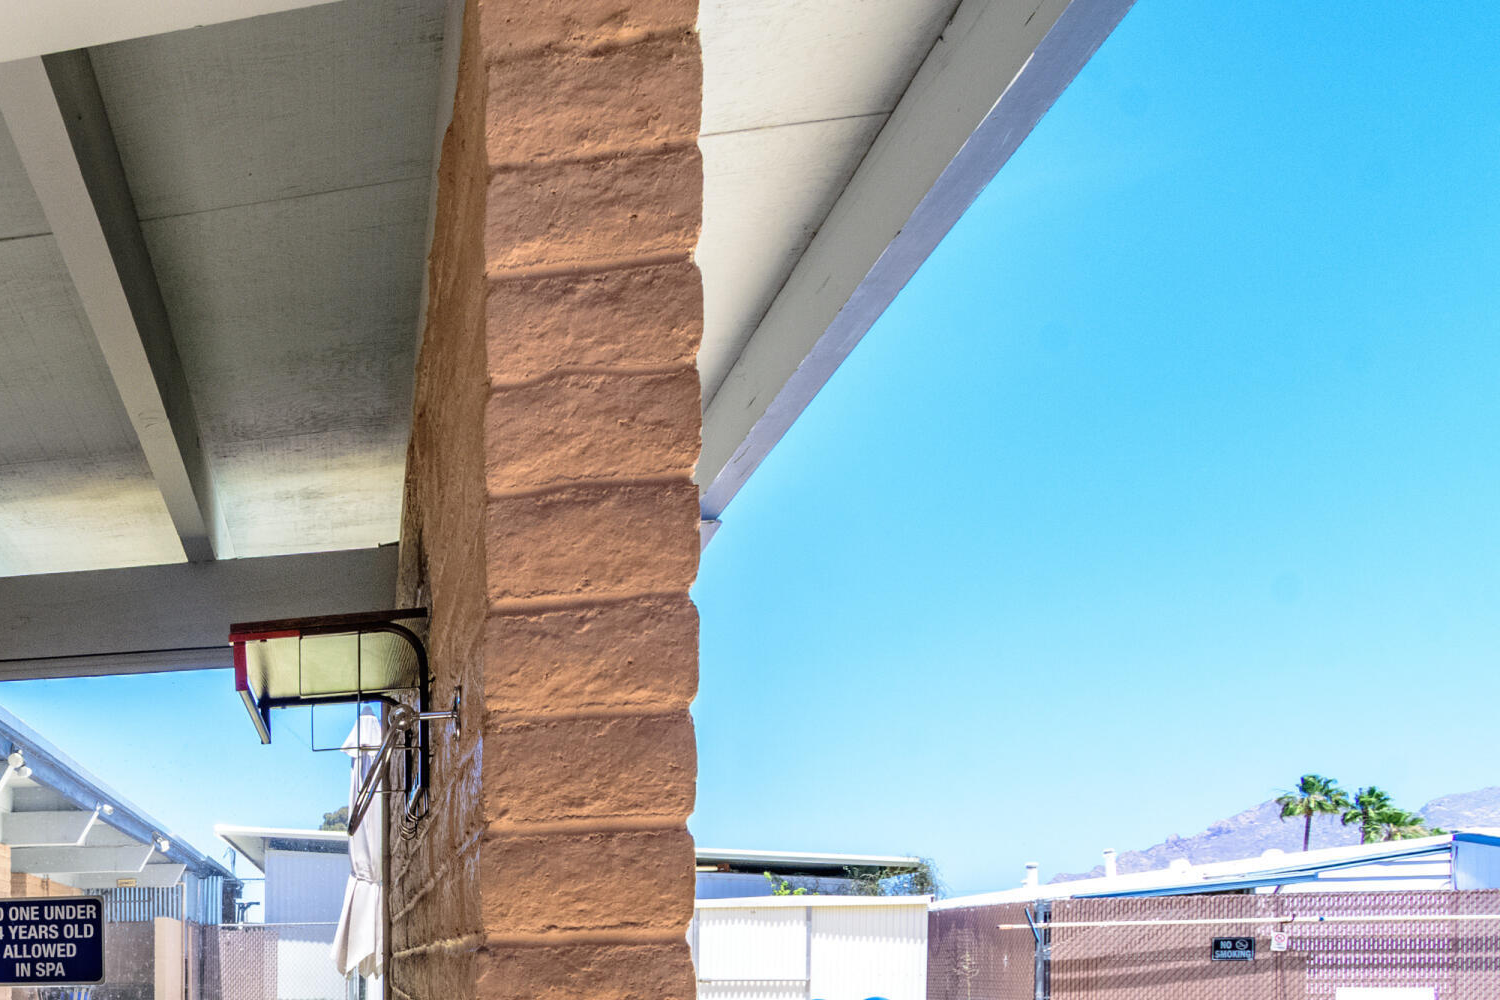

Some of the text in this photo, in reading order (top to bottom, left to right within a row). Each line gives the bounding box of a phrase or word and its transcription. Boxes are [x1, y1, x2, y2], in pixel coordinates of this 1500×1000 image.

[8, 906, 40, 921] ONE
[44, 905, 96, 920] UNDER
[9, 925, 59, 940] YEARS
[63, 924, 94, 939] OLD
[2, 943, 77, 959] ALLOWED
[1220, 940, 1232, 949] NO
[1214, 950, 1252, 959] SMOKING
[15, 962, 65, 977] IN SPA
